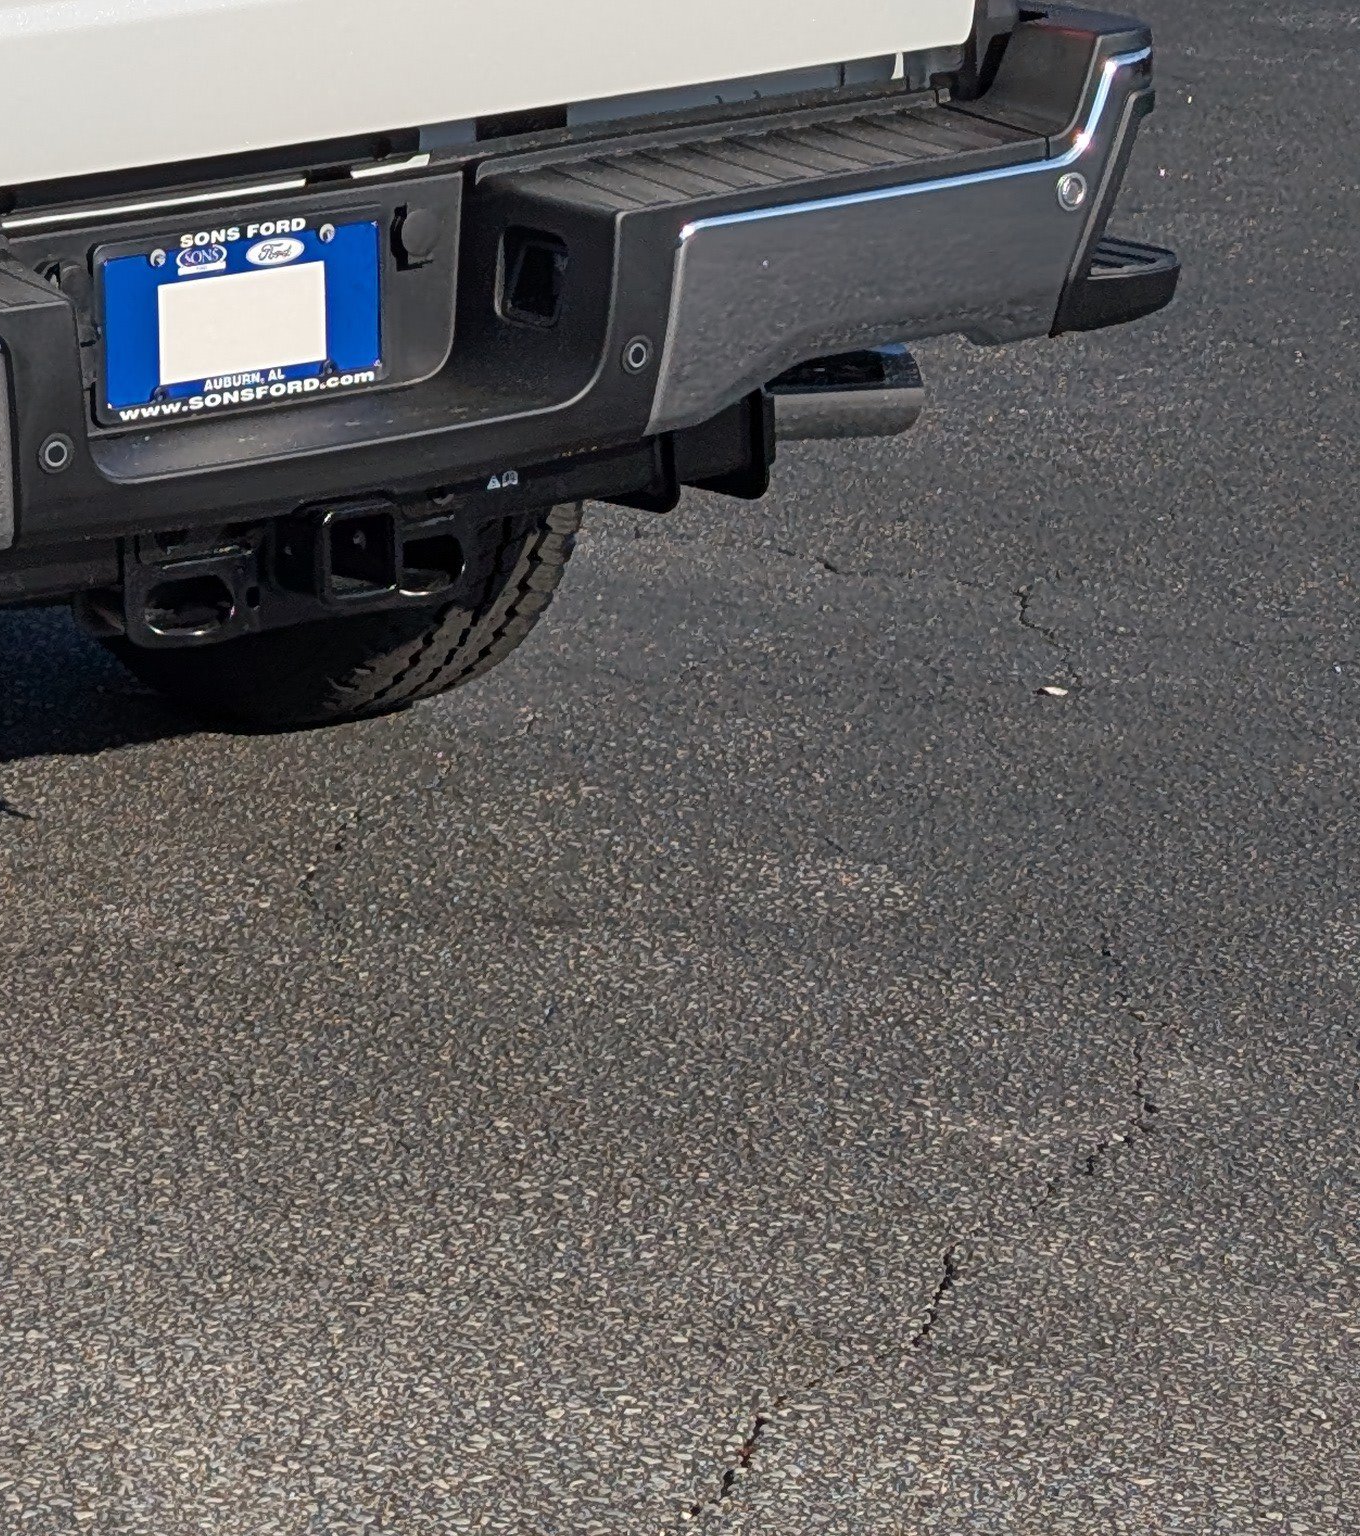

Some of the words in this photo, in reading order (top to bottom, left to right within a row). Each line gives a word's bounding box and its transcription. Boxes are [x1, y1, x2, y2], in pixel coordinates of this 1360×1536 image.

[180, 226, 240, 248] SONS
[247, 217, 306, 239] FORD
[184, 247, 220, 267] SONS
[258, 242, 293, 261] Ford
[204, 373, 266, 392] AUBURN,
[268, 369, 285, 381] AL
[119, 370, 375, 421] www.SONSFORD.com
